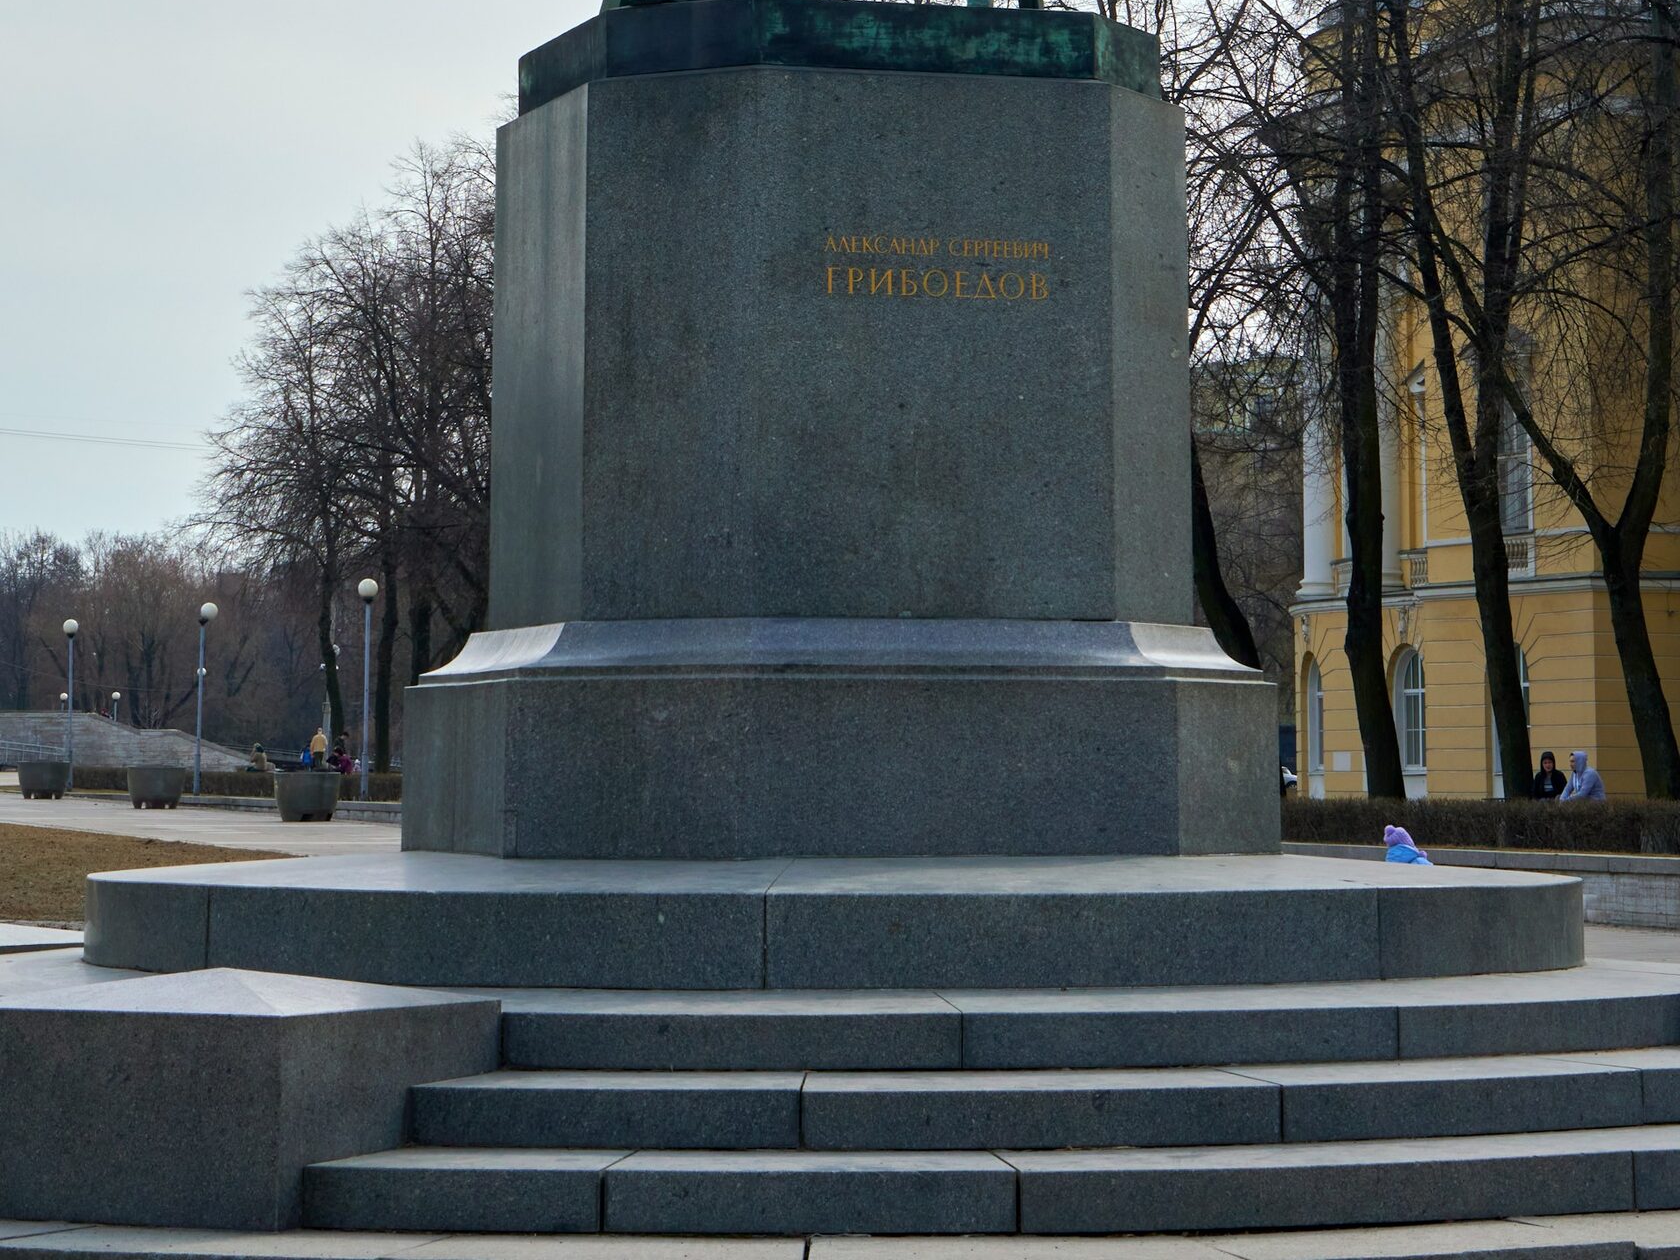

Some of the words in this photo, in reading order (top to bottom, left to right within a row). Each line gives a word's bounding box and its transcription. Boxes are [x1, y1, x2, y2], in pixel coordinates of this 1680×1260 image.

[824, 235, 940, 256] АЛЕКСАНДР
[949, 238, 1049, 260] СЕРГЕЕВИЧ
[826, 265, 1049, 300] ГРИБОЕДОВ
